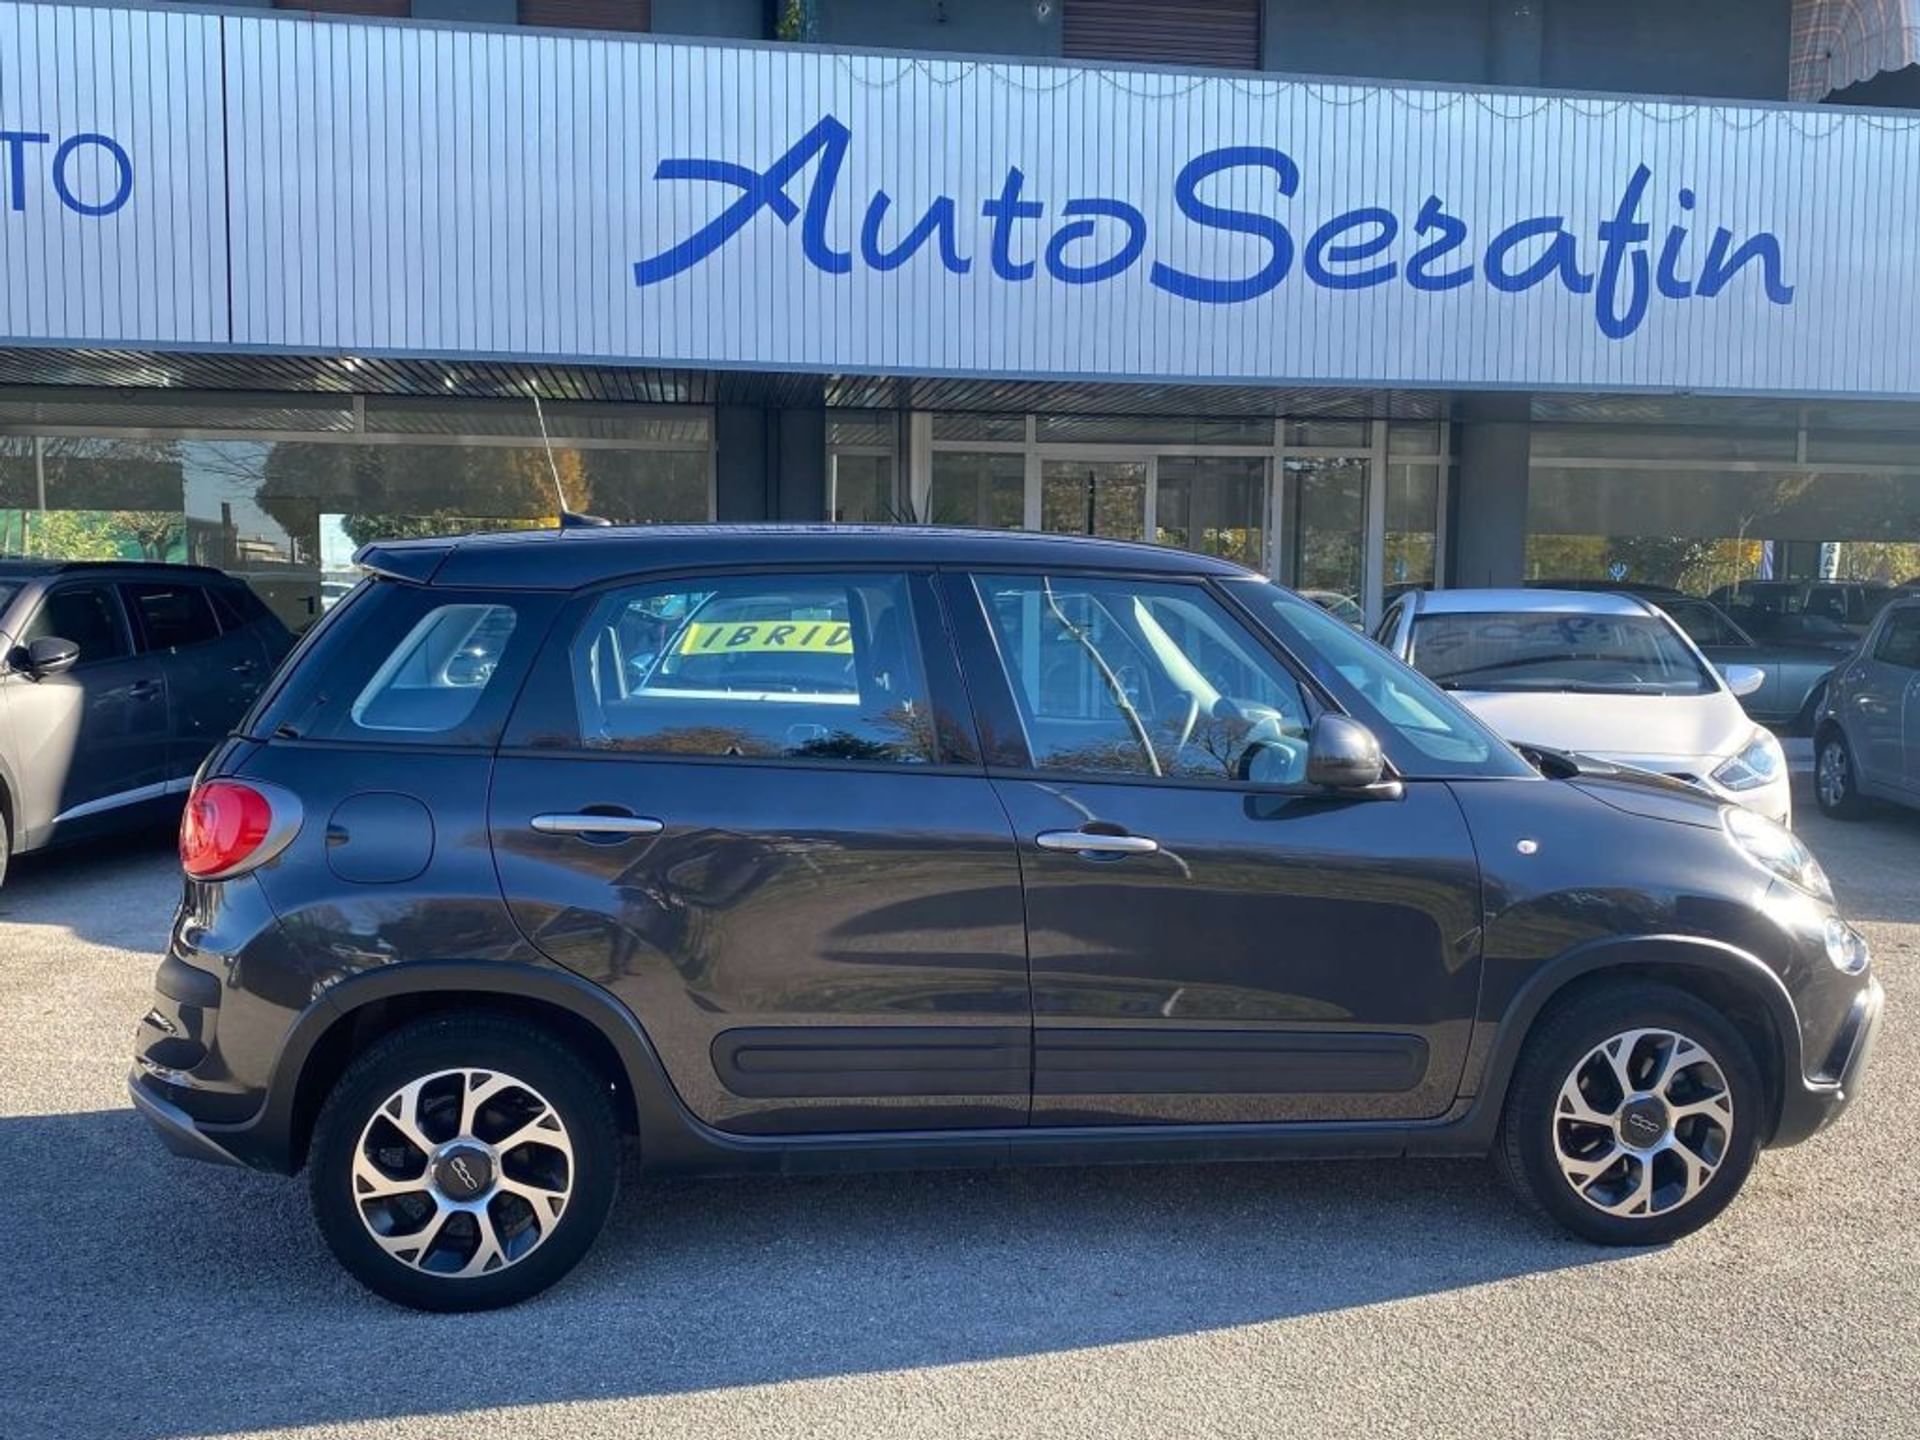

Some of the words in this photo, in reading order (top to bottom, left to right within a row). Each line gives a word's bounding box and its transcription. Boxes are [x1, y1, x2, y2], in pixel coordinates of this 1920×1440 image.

[0, 131, 133, 217] TO
[634, 116, 1794, 339] AutoSerafin
[701, 625, 851, 649] IBRID
